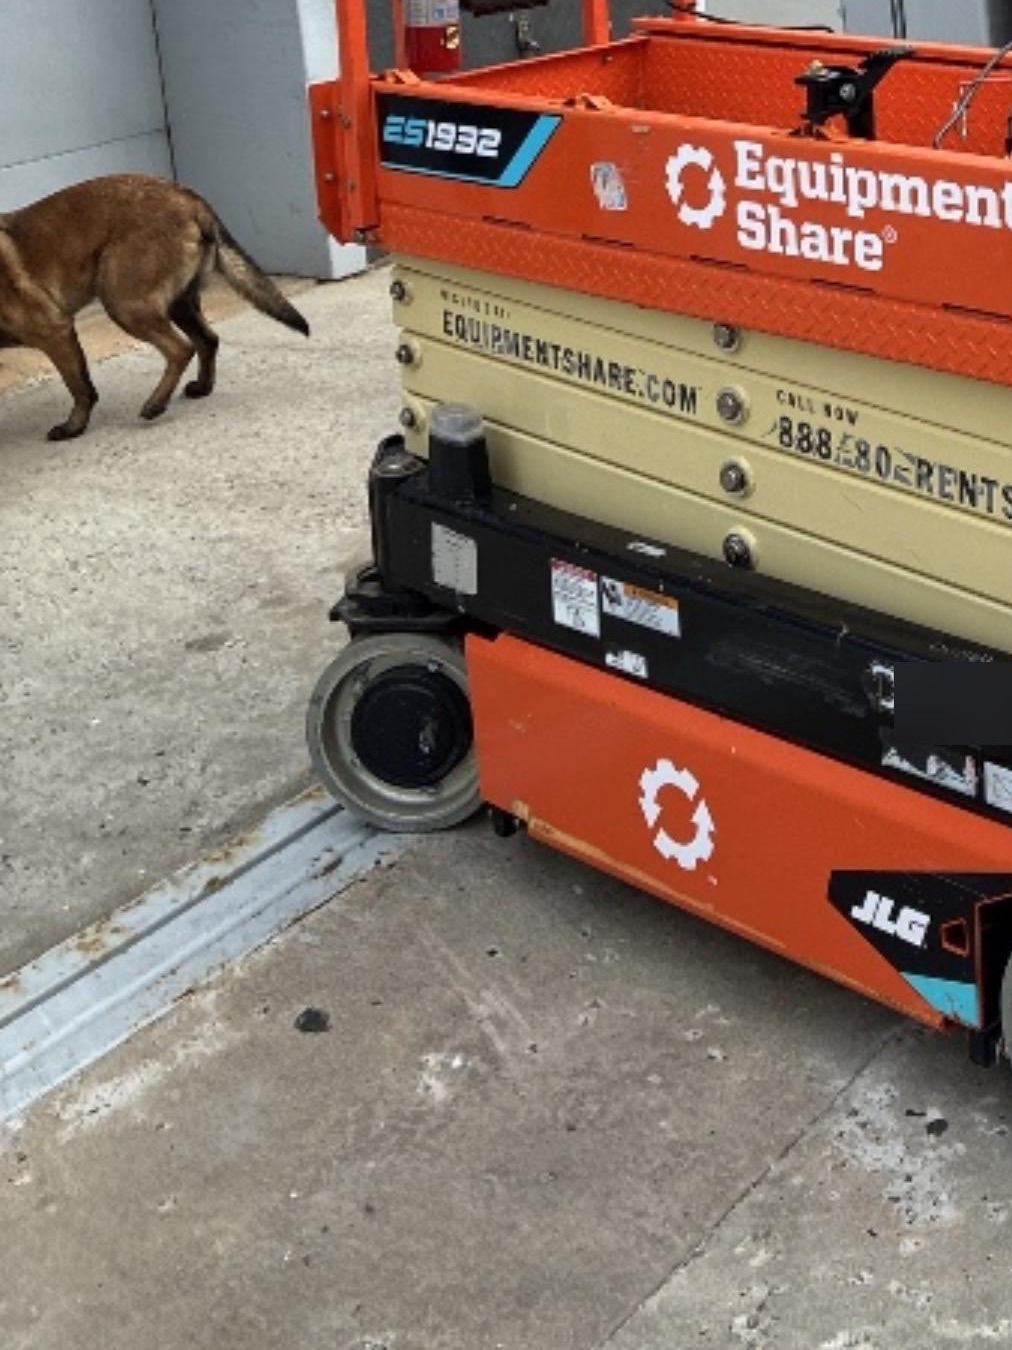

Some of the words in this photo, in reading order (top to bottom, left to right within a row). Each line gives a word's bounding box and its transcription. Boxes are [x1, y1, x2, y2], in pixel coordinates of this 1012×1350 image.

[382, 114, 502, 158] ES1932
[442, 307, 700, 416] EQUIPMENTSHARE.COM
[850, 889, 931, 949] JLG
